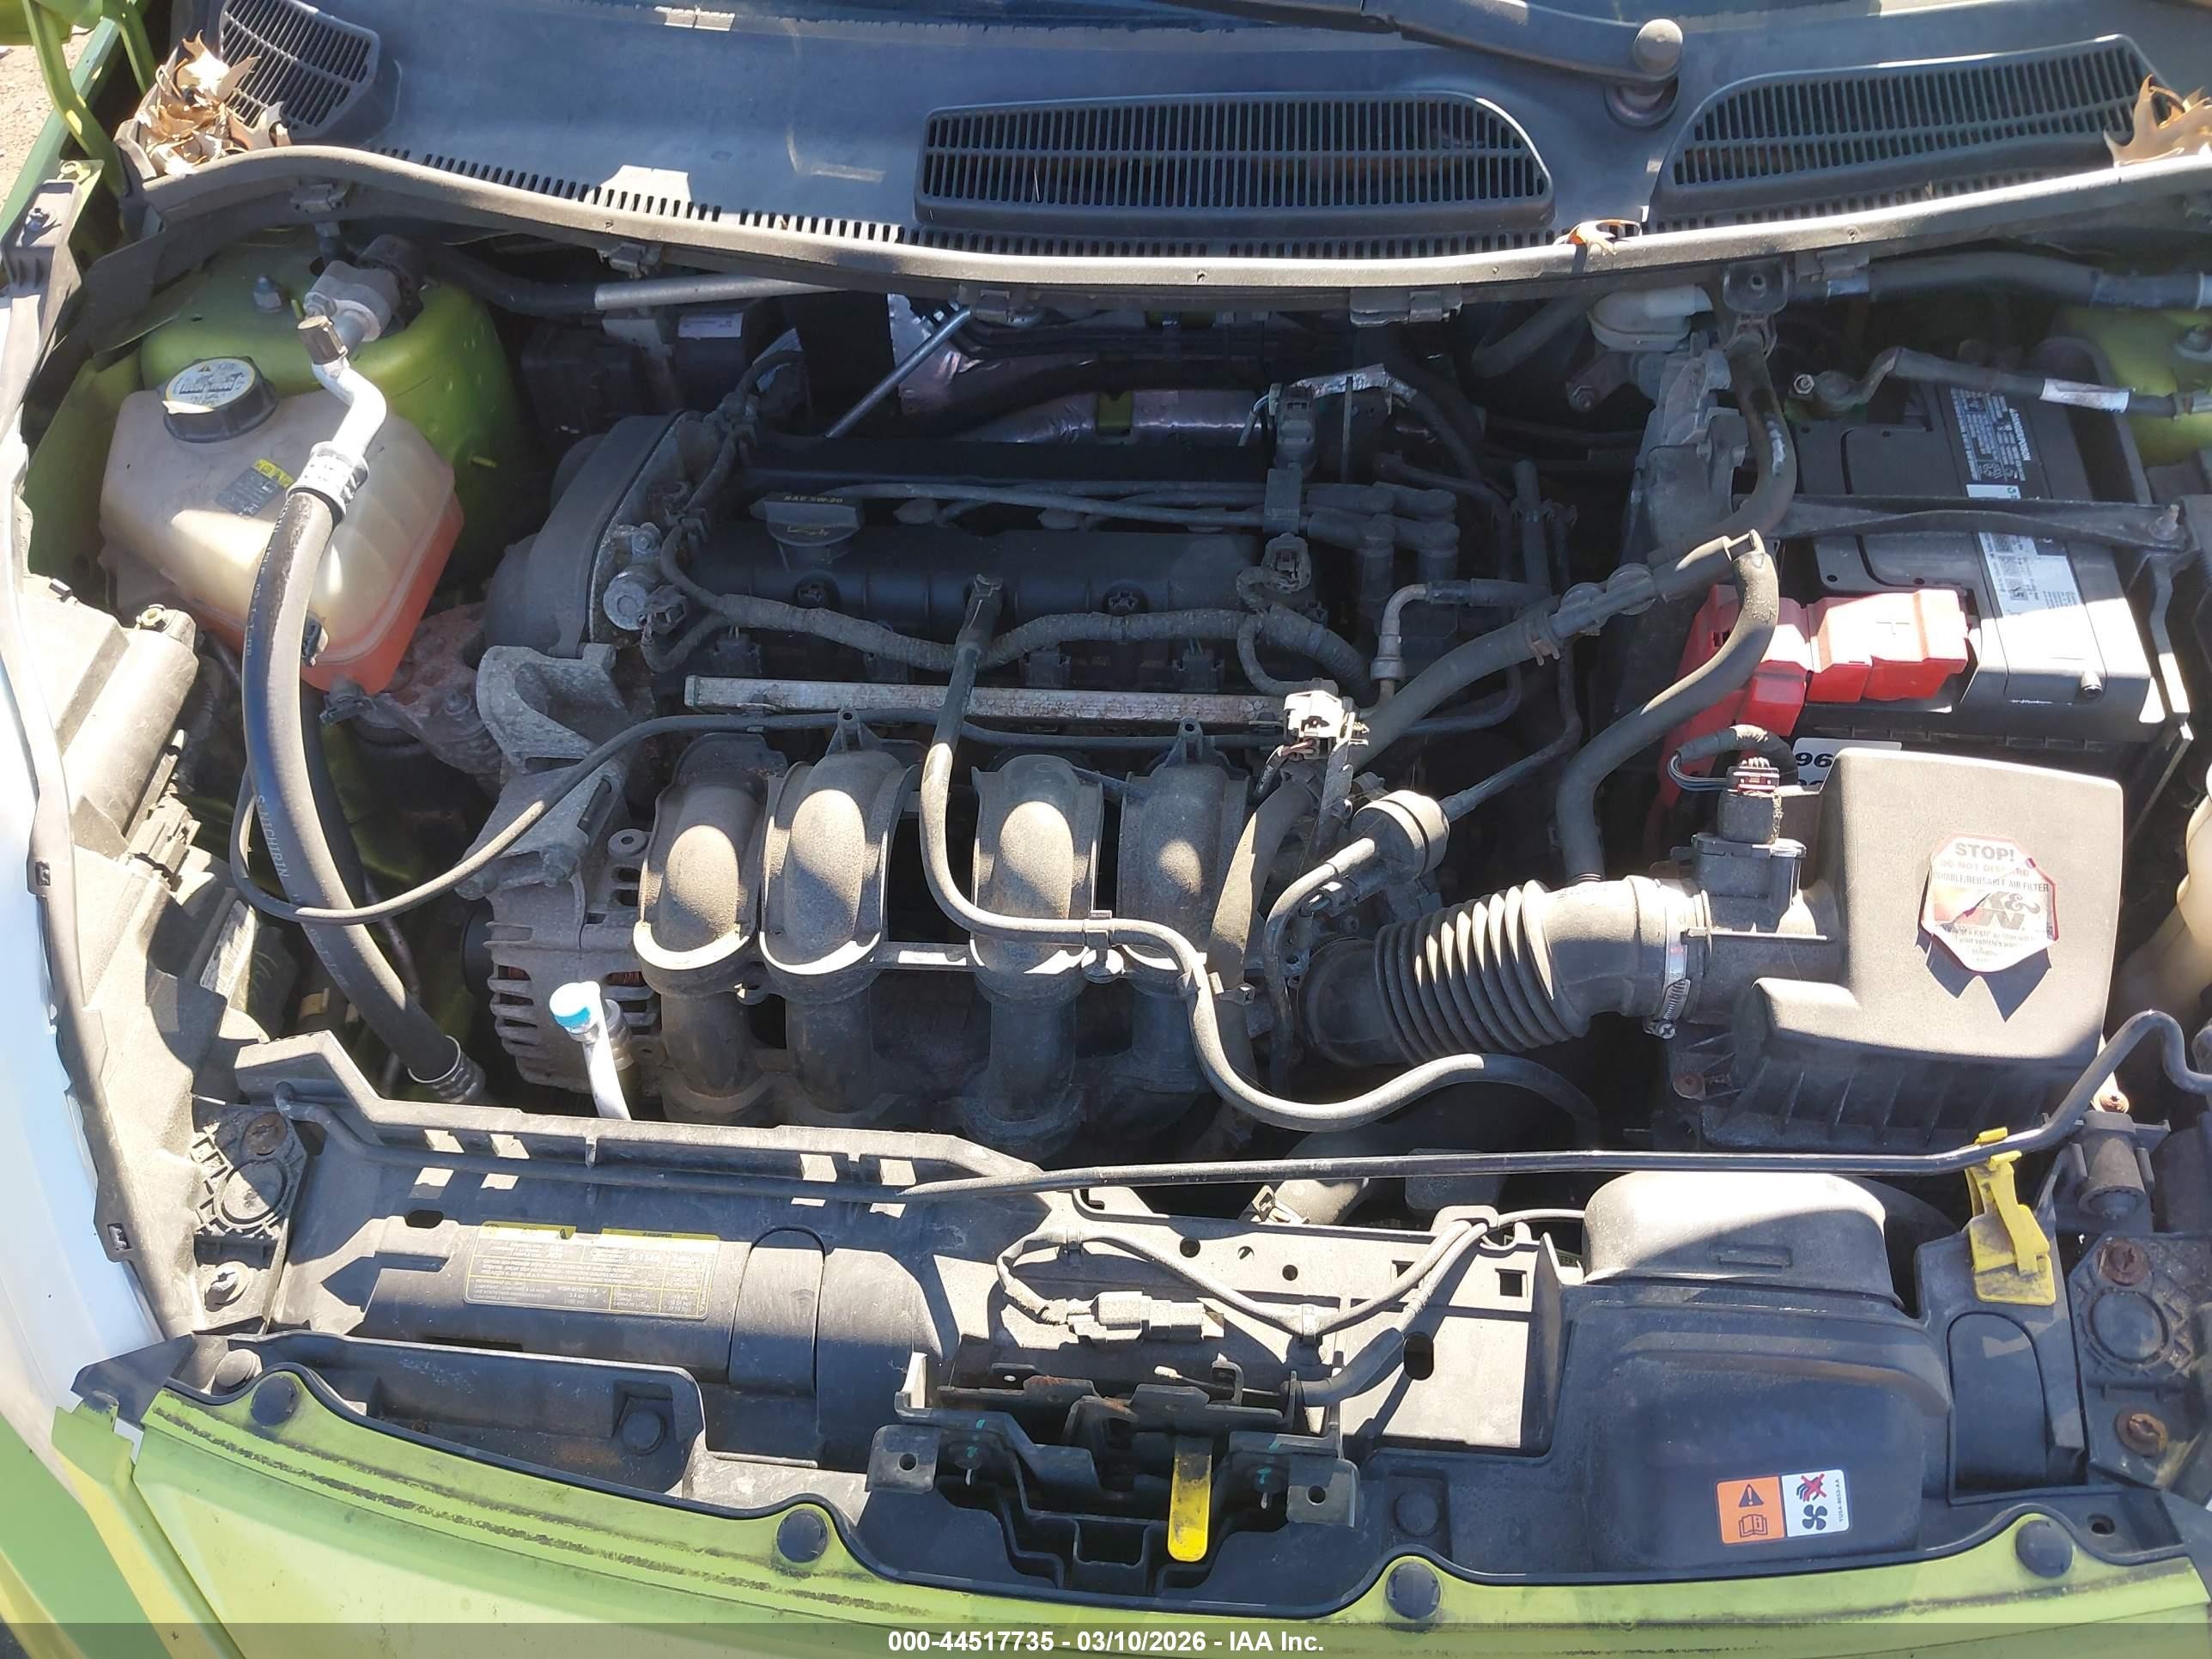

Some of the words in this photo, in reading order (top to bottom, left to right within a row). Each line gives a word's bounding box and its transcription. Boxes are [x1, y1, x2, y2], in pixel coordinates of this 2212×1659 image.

[1954, 842, 2015, 861] STOP!
[1959, 861, 1979, 871] NOT
[2023, 881, 2049, 892] FILTER
